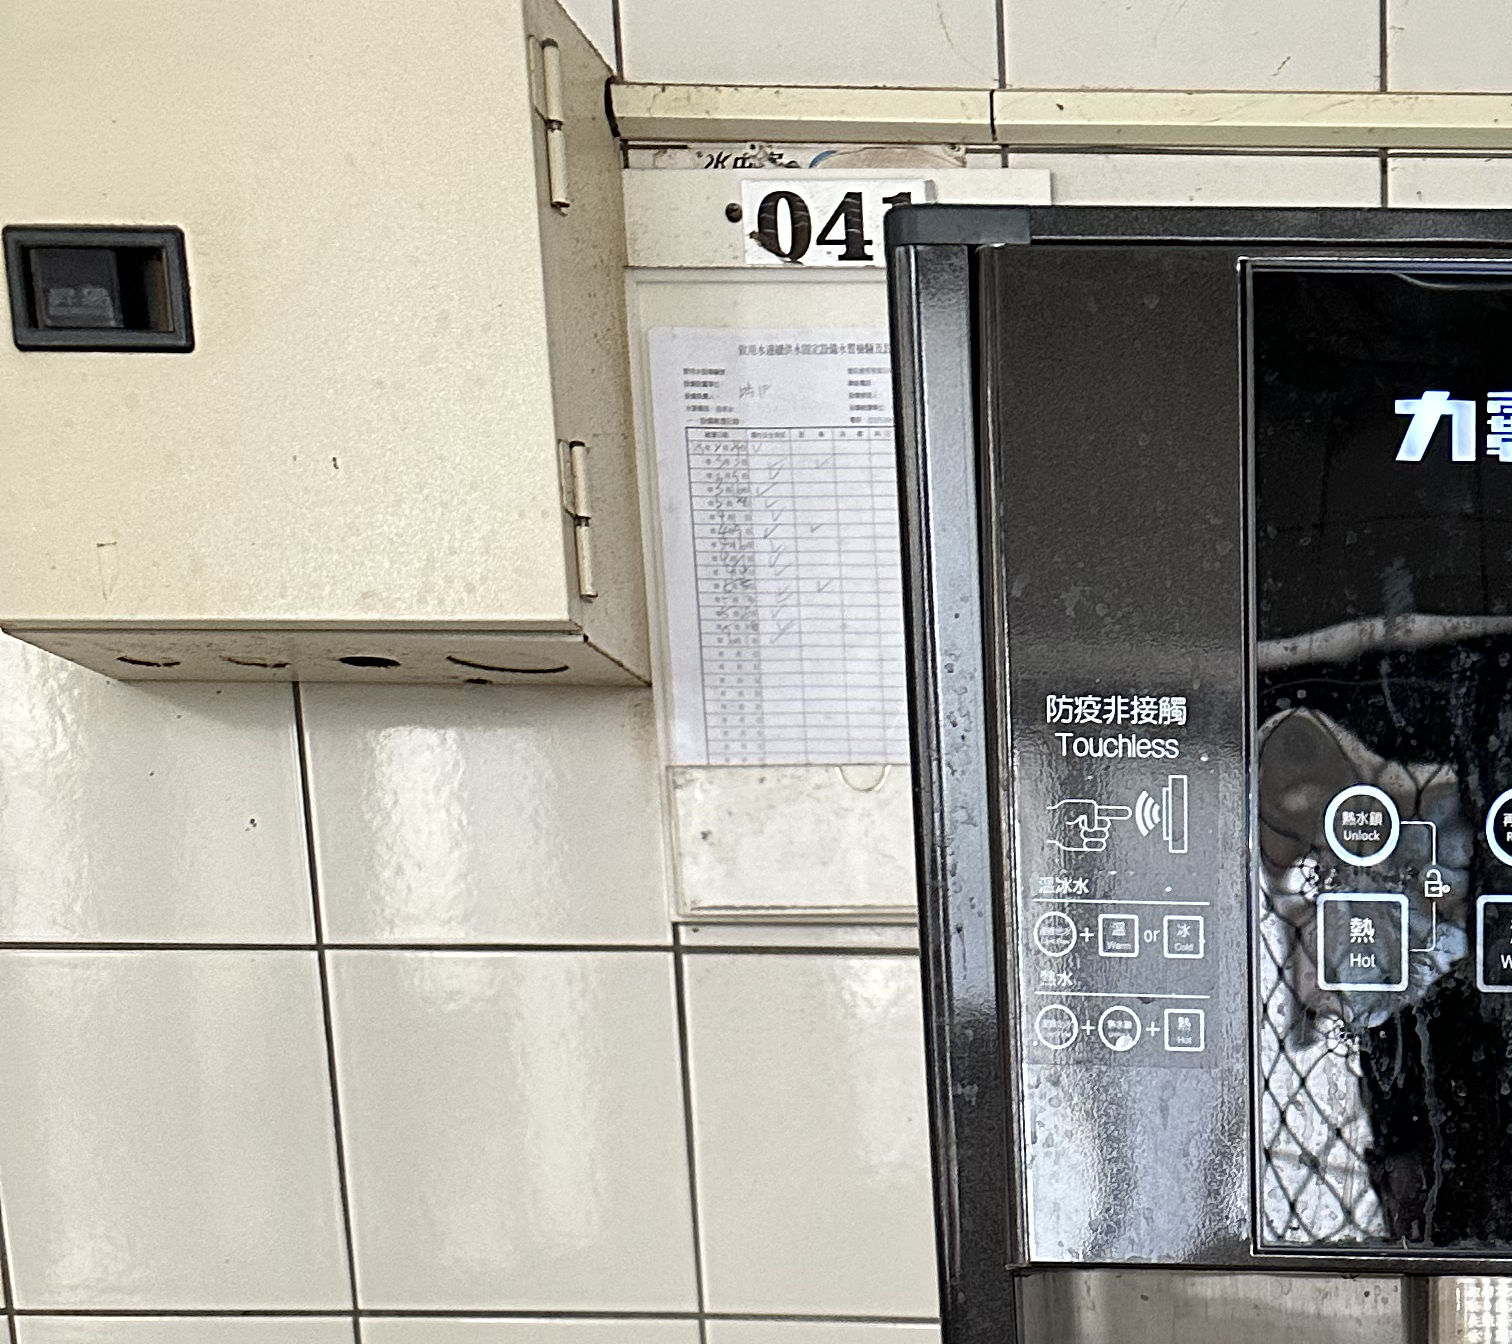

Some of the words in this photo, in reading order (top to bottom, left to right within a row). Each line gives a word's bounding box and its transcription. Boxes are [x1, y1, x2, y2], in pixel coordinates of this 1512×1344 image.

[757, 190, 911, 262] 04
[1045, 694, 1188, 726] 防疫非接觸
[1054, 732, 1180, 759] Touchless
[1343, 830, 1381, 842] Unlock
[1143, 929, 1161, 943] or
[1176, 923, 1191, 938] 冰
[1350, 917, 1376, 944] 熱
[1350, 953, 1376, 968] Hot
